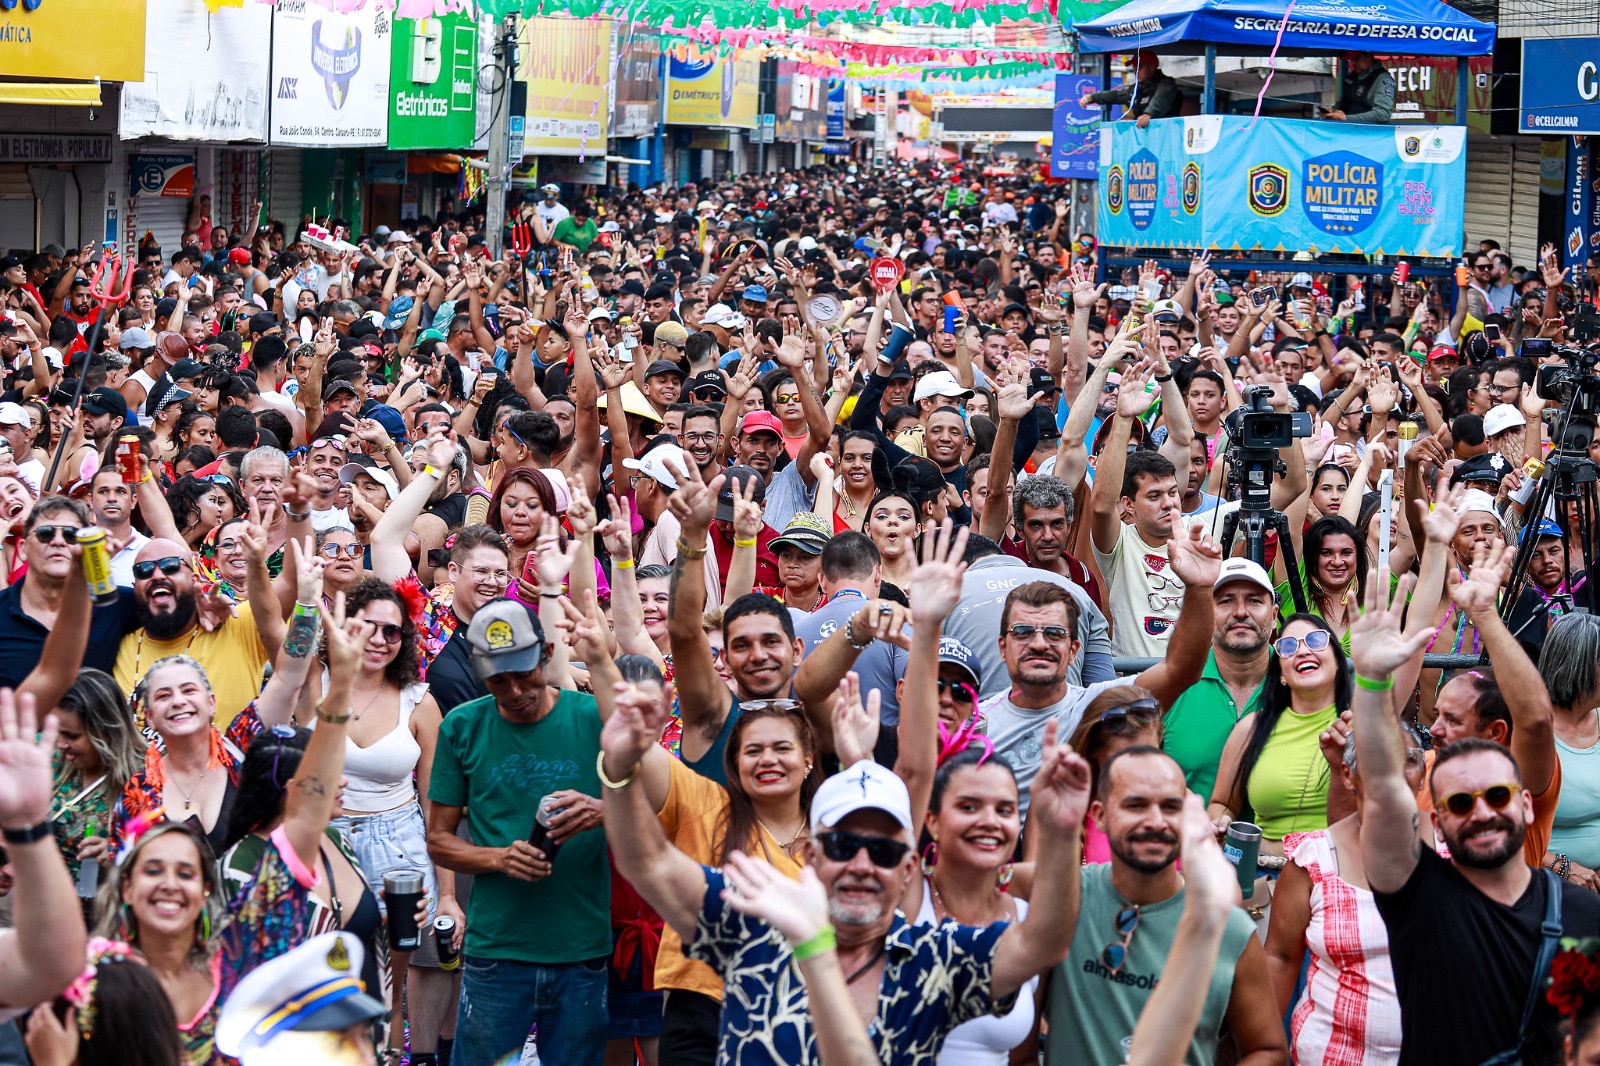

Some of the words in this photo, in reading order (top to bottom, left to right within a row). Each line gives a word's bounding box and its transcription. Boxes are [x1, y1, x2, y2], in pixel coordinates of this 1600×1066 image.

[1350, 4, 1388, 12] ESTADO
[1234, 17, 1330, 35] SECRETARIA
[1333, 23, 1357, 36] DE
[1357, 24, 1417, 39] DEFESA
[1419, 26, 1478, 43] SOCIAL
[396, 90, 448, 117] Eletrônicos
[1535, 115, 1579, 127] @CELLGILMAR
[68, 139, 103, 158] POPULAR
[1308, 162, 1377, 185] POLÍCIA
[1305, 185, 1378, 207] MILITAR
[1397, 203, 1436, 216] BUCO
[987, 578, 1015, 590] GNC
[938, 647, 968, 662] OLCCI
[1083, 959, 1161, 990] alasol
